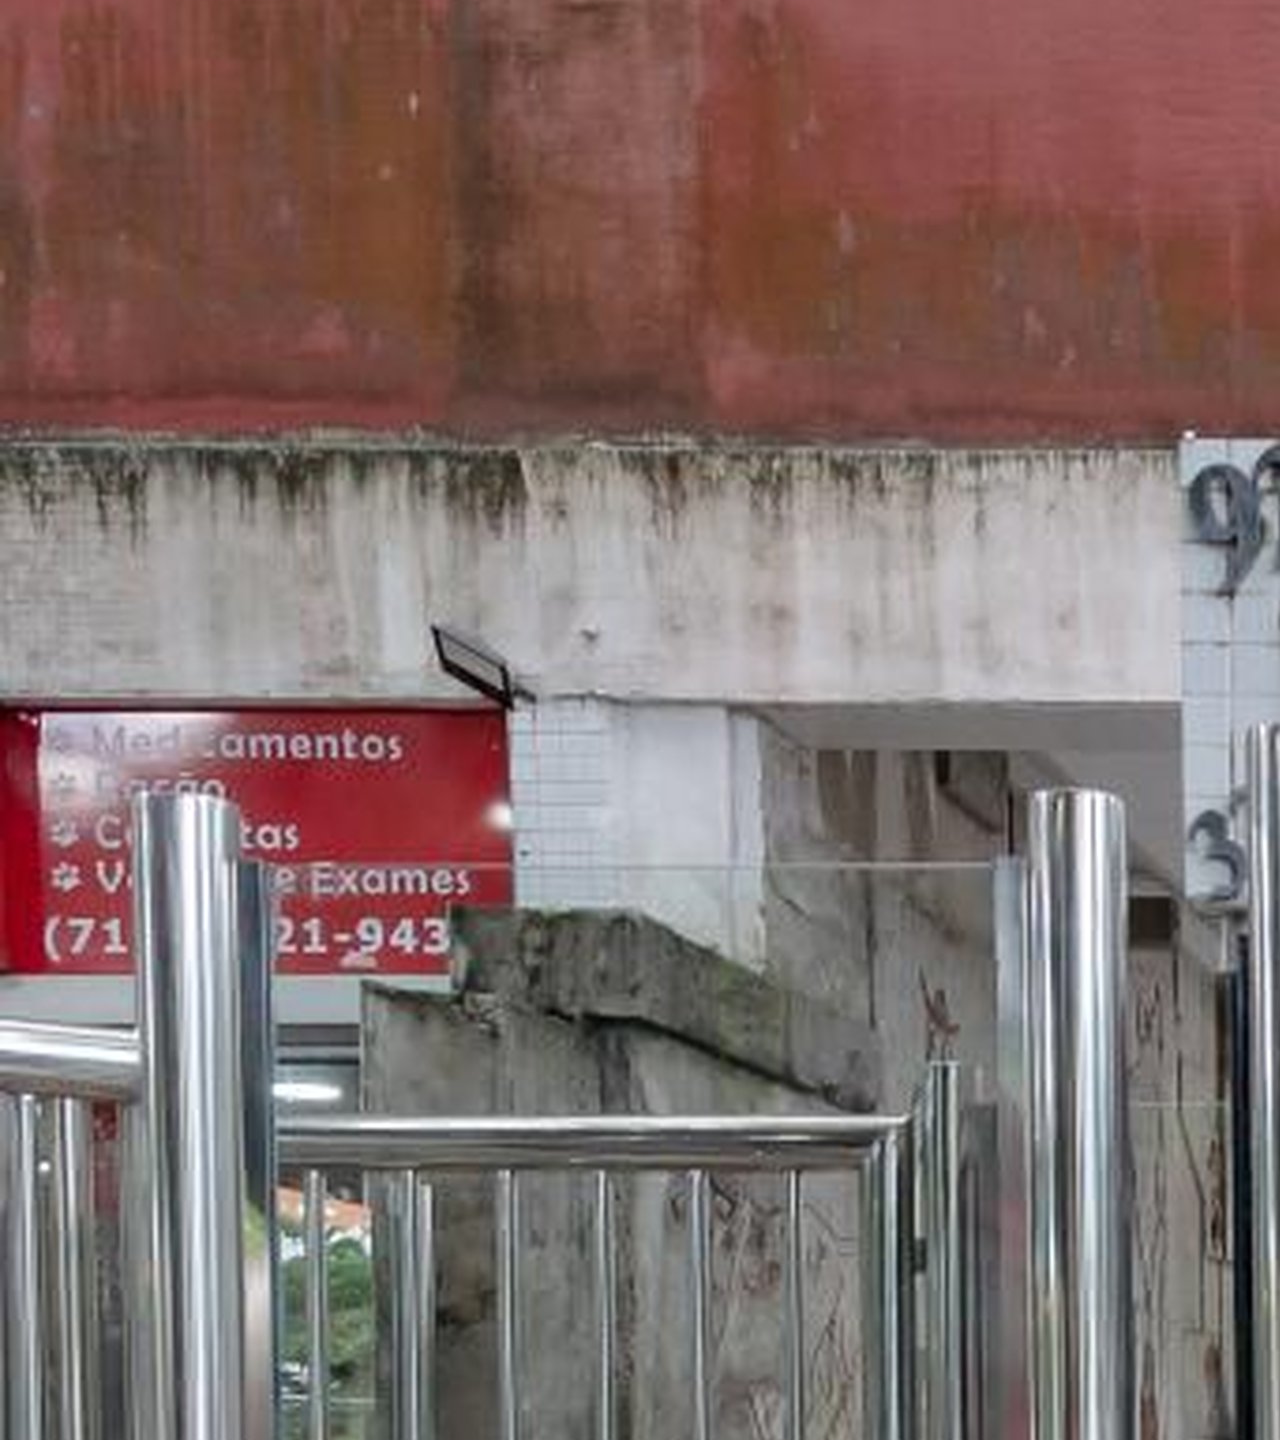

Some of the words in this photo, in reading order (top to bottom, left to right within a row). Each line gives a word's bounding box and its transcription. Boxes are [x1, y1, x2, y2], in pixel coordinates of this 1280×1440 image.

[93, 726, 403, 759] Medcamentos
[312, 864, 471, 895] Exames
[44, 917, 129, 962] (71
[275, 916, 450, 954] 21-943
